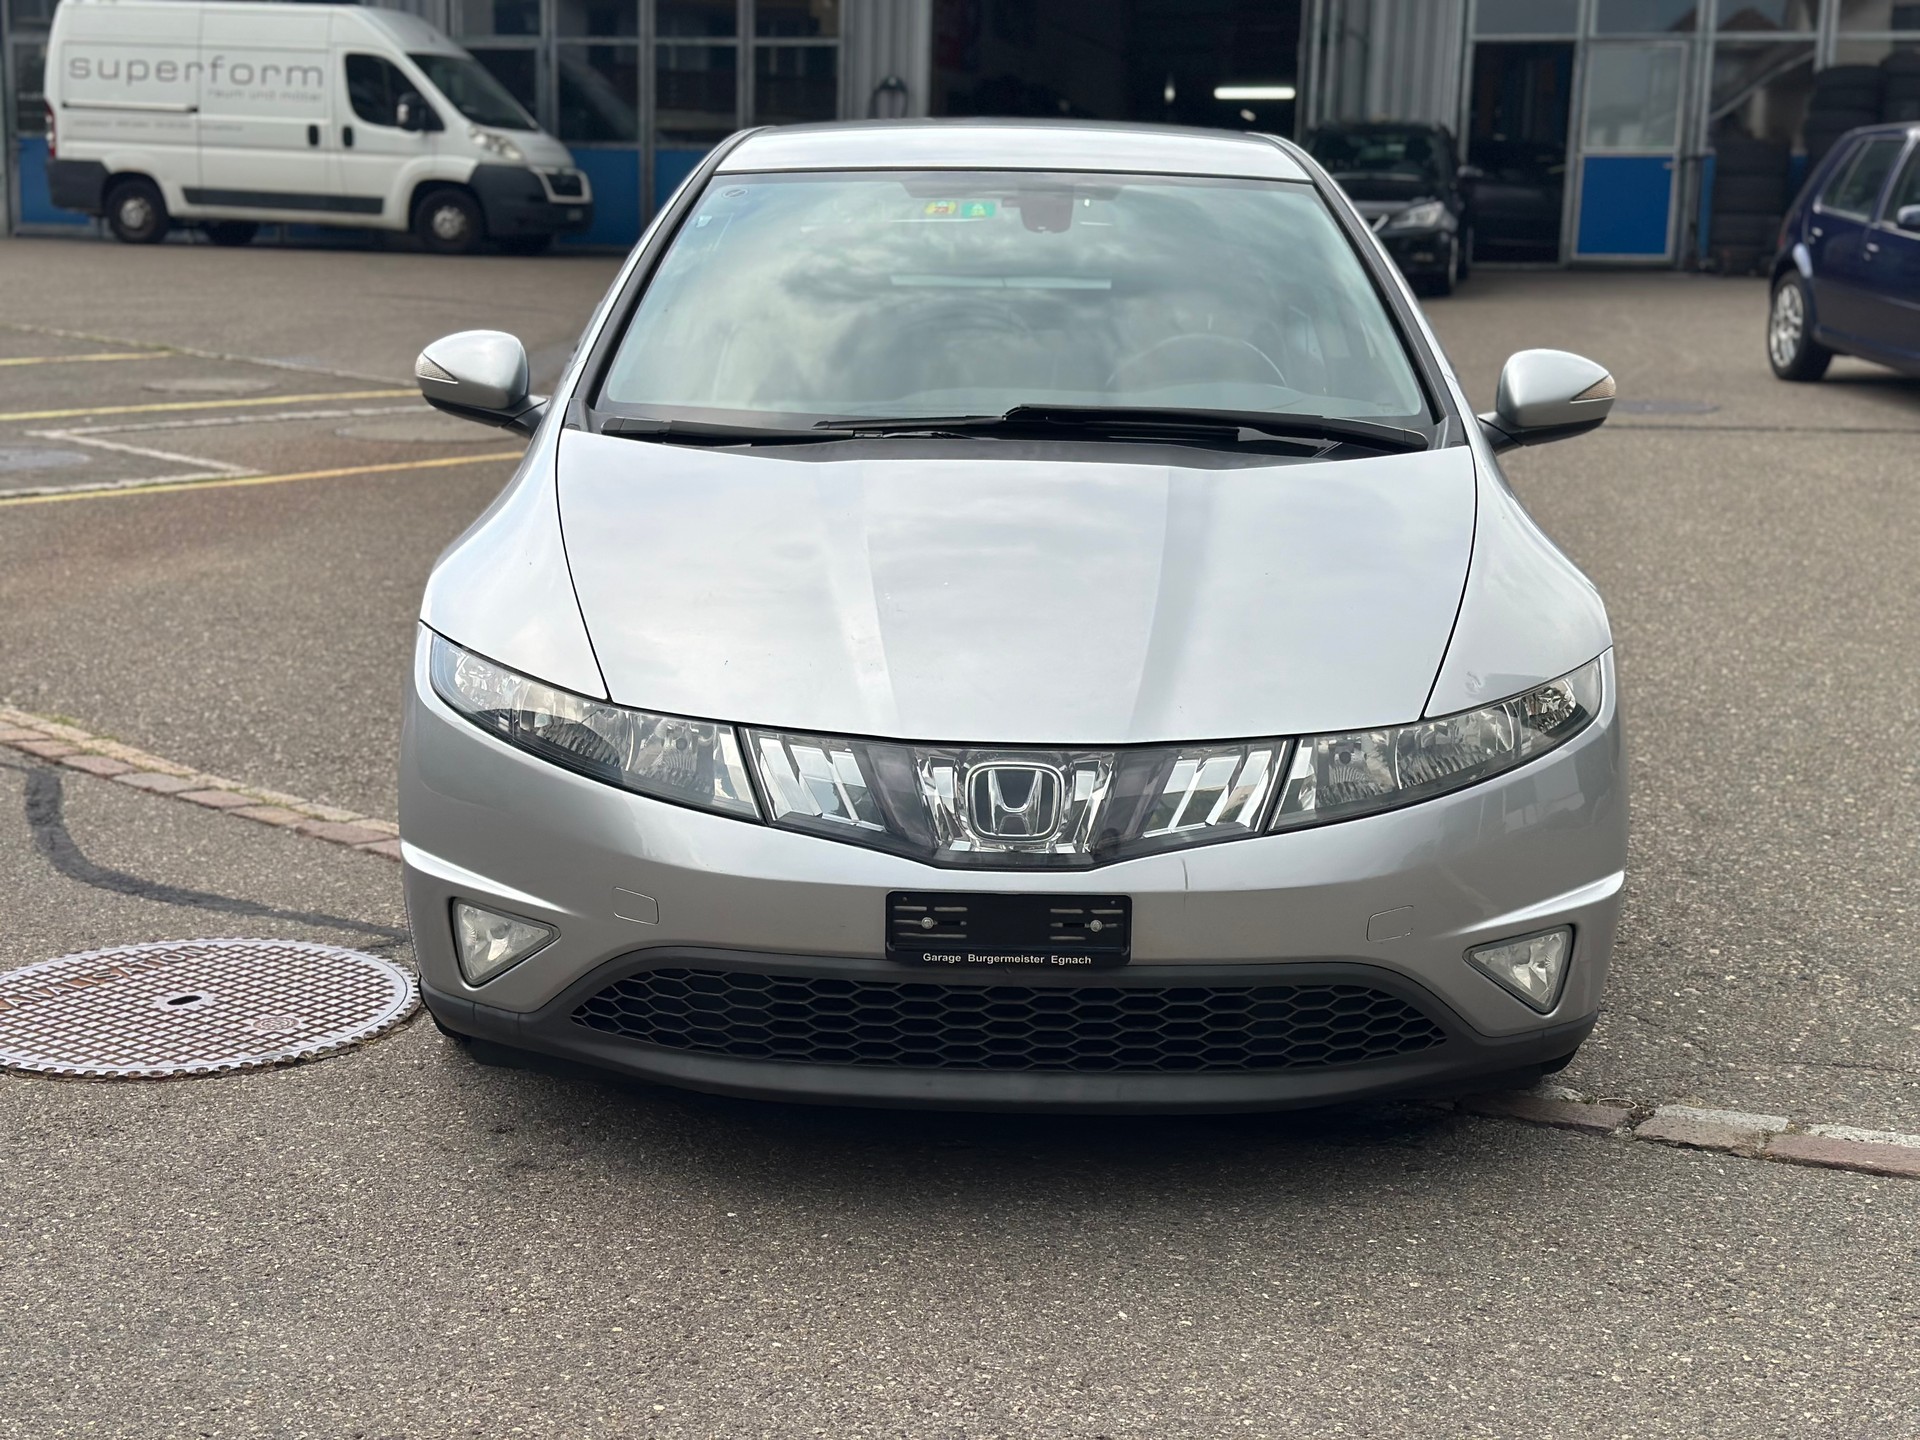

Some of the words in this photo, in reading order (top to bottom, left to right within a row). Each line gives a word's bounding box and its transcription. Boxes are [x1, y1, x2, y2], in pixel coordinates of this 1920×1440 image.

[68, 55, 325, 88] superform
[922, 952, 962, 964] Garage
[967, 953, 1045, 965] Burgermeister
[1050, 955, 1092, 966] Egnach
[0, 946, 208, 1011] ANALISATION
